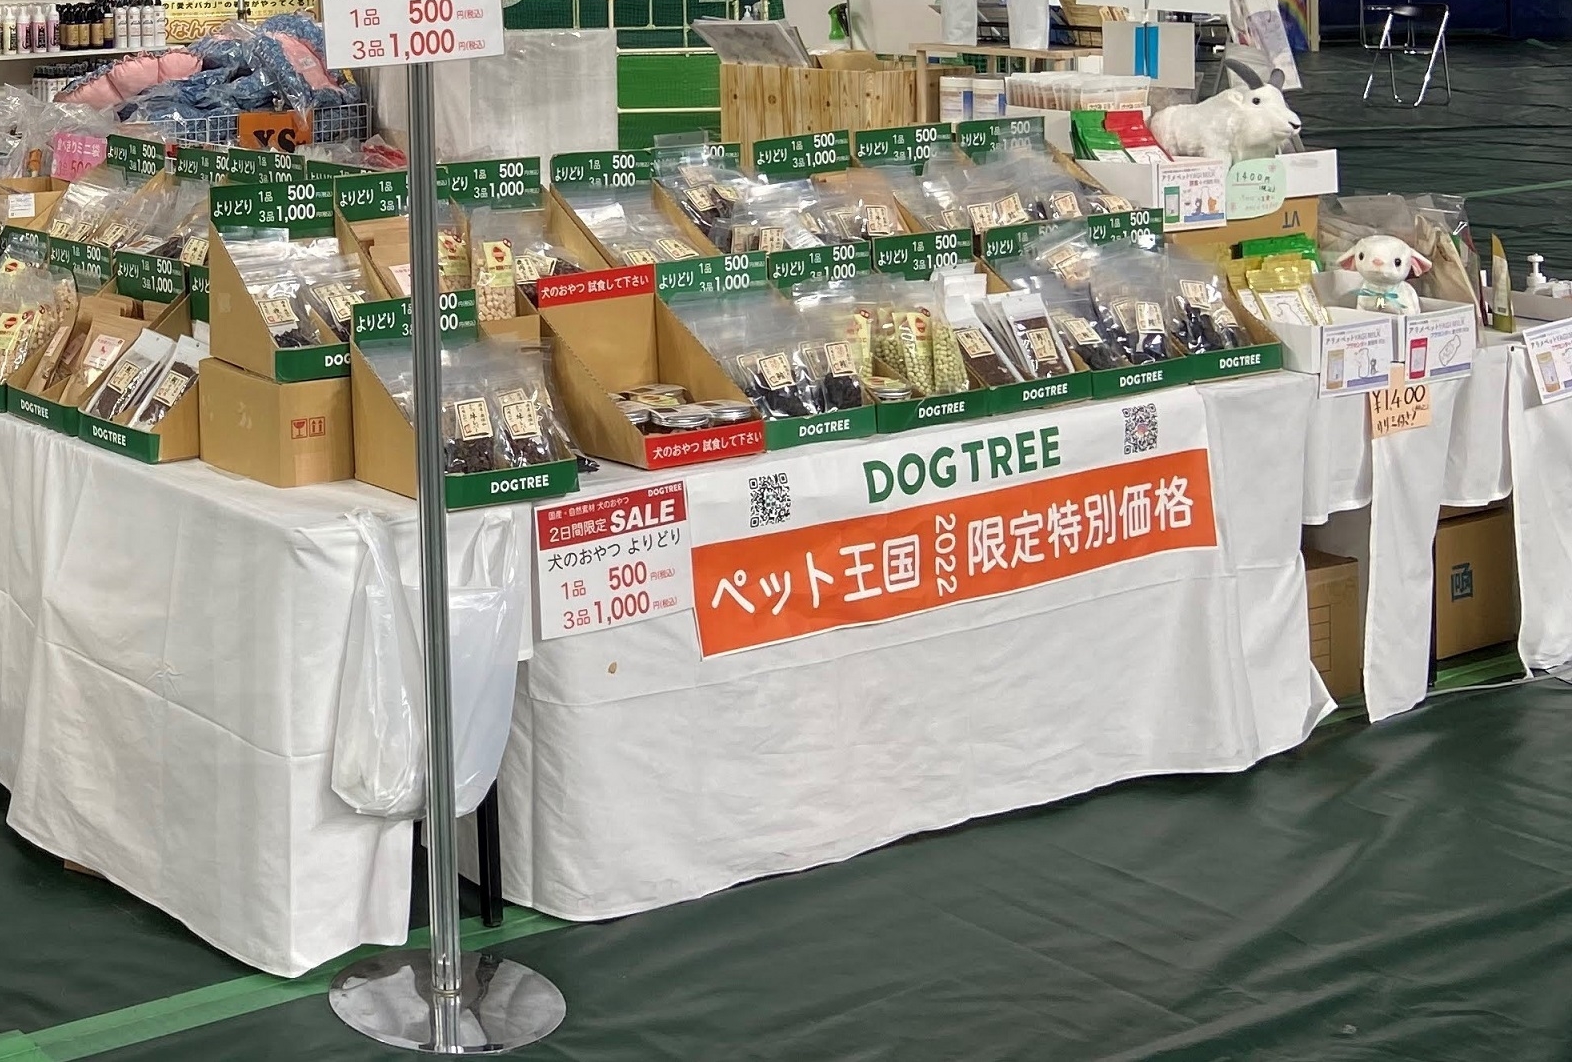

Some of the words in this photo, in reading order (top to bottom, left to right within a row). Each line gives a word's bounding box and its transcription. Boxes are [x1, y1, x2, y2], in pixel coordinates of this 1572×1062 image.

[117, 263, 139, 279] よりどり
[541, 284, 585, 300] 犬のおやつ
[588, 274, 649, 292] 試食して下さい
[1219, 353, 1261, 369] DOGTREE
[1119, 370, 1163, 387] DOGTREE
[1023, 382, 1068, 401] DOGTREE
[918, 401, 965, 418] DOGTREE
[92, 425, 127, 446] DOGTREE
[799, 419, 850, 437] DOGTREE
[653, 443, 700, 460] 犬のおやつ
[702, 432, 762, 452] 試食して下さい
[862, 425, 1062, 505] DOGTREE
[490, 474, 550, 493] DOGTREE
[648, 484, 682, 497] DOGTREE
[549, 519, 607, 543] 2日間限定
[610, 499, 675, 533] SALE
[548, 543, 621, 572] 犬のおやつ
[628, 528, 680, 555] よりどり
[710, 535, 921, 617] ペット王国
[934, 512, 957, 597] 2022
[966, 474, 1195, 575] 限定特別価格
